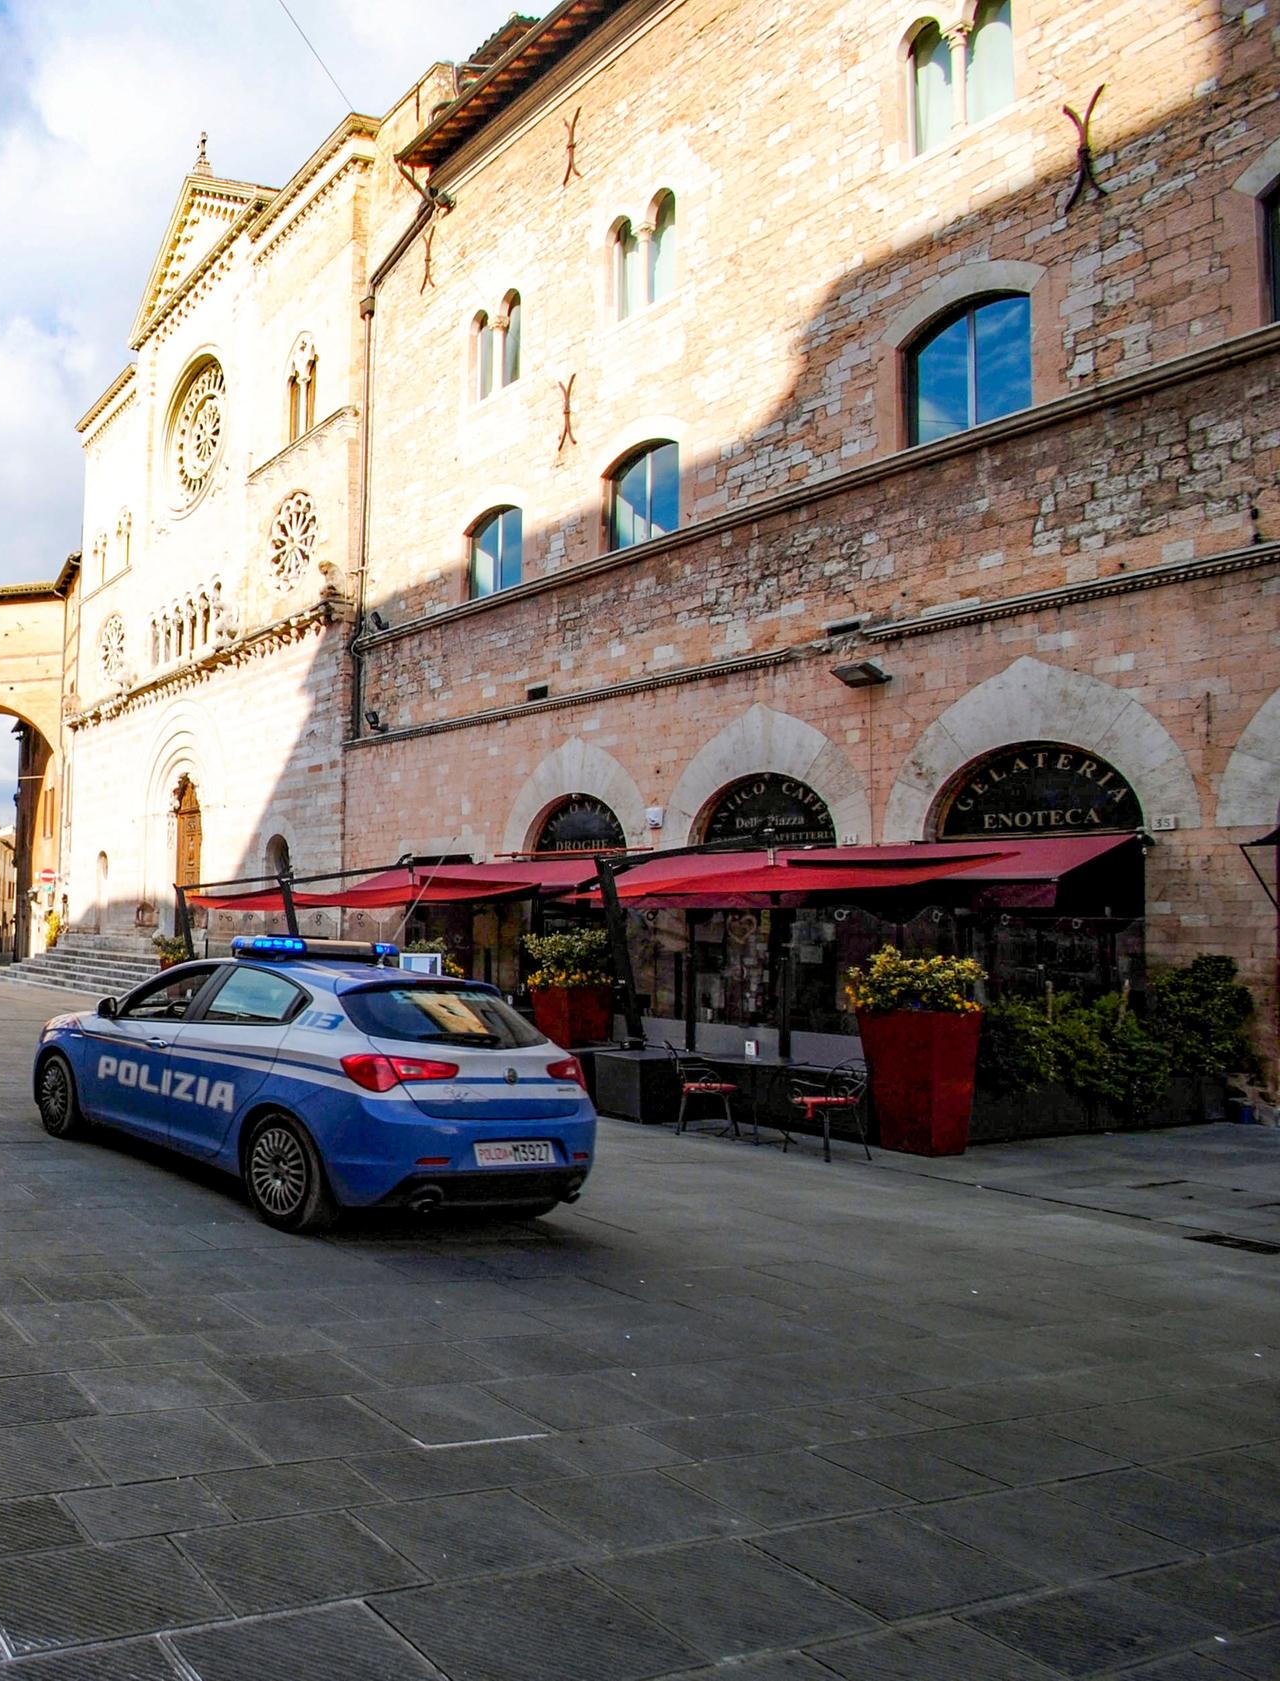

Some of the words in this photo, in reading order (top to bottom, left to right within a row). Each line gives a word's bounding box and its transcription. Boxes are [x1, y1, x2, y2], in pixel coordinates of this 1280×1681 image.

[957, 752, 1128, 811] GELATERIA
[767, 815, 805, 827] Piazza
[983, 808, 1101, 829] ENOTECA
[556, 839, 608, 851] DROGHE
[296, 1010, 346, 1030] 113
[97, 1055, 235, 1113] POLIZIA
[511, 1143, 550, 1162] M3927
